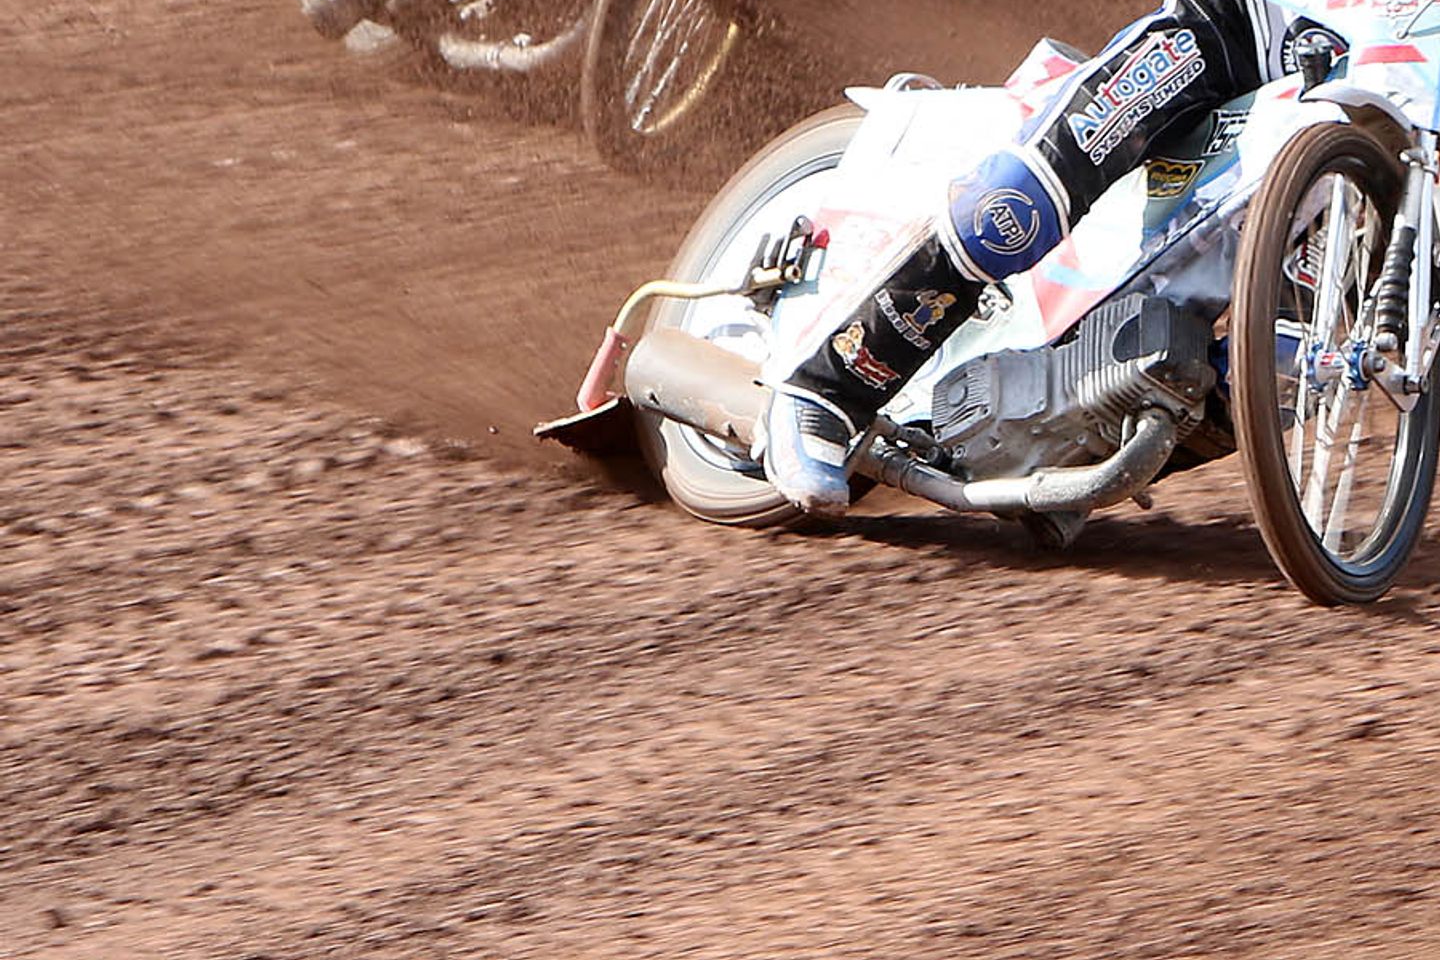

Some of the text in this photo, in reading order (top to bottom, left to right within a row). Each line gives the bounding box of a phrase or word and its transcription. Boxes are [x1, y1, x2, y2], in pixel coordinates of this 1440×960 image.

[1072, 29, 1197, 146] Autogate
[1091, 99, 1152, 164] SYSTEMS
[1153, 59, 1205, 108] LIMITED
[989, 203, 1026, 247] ATPI
